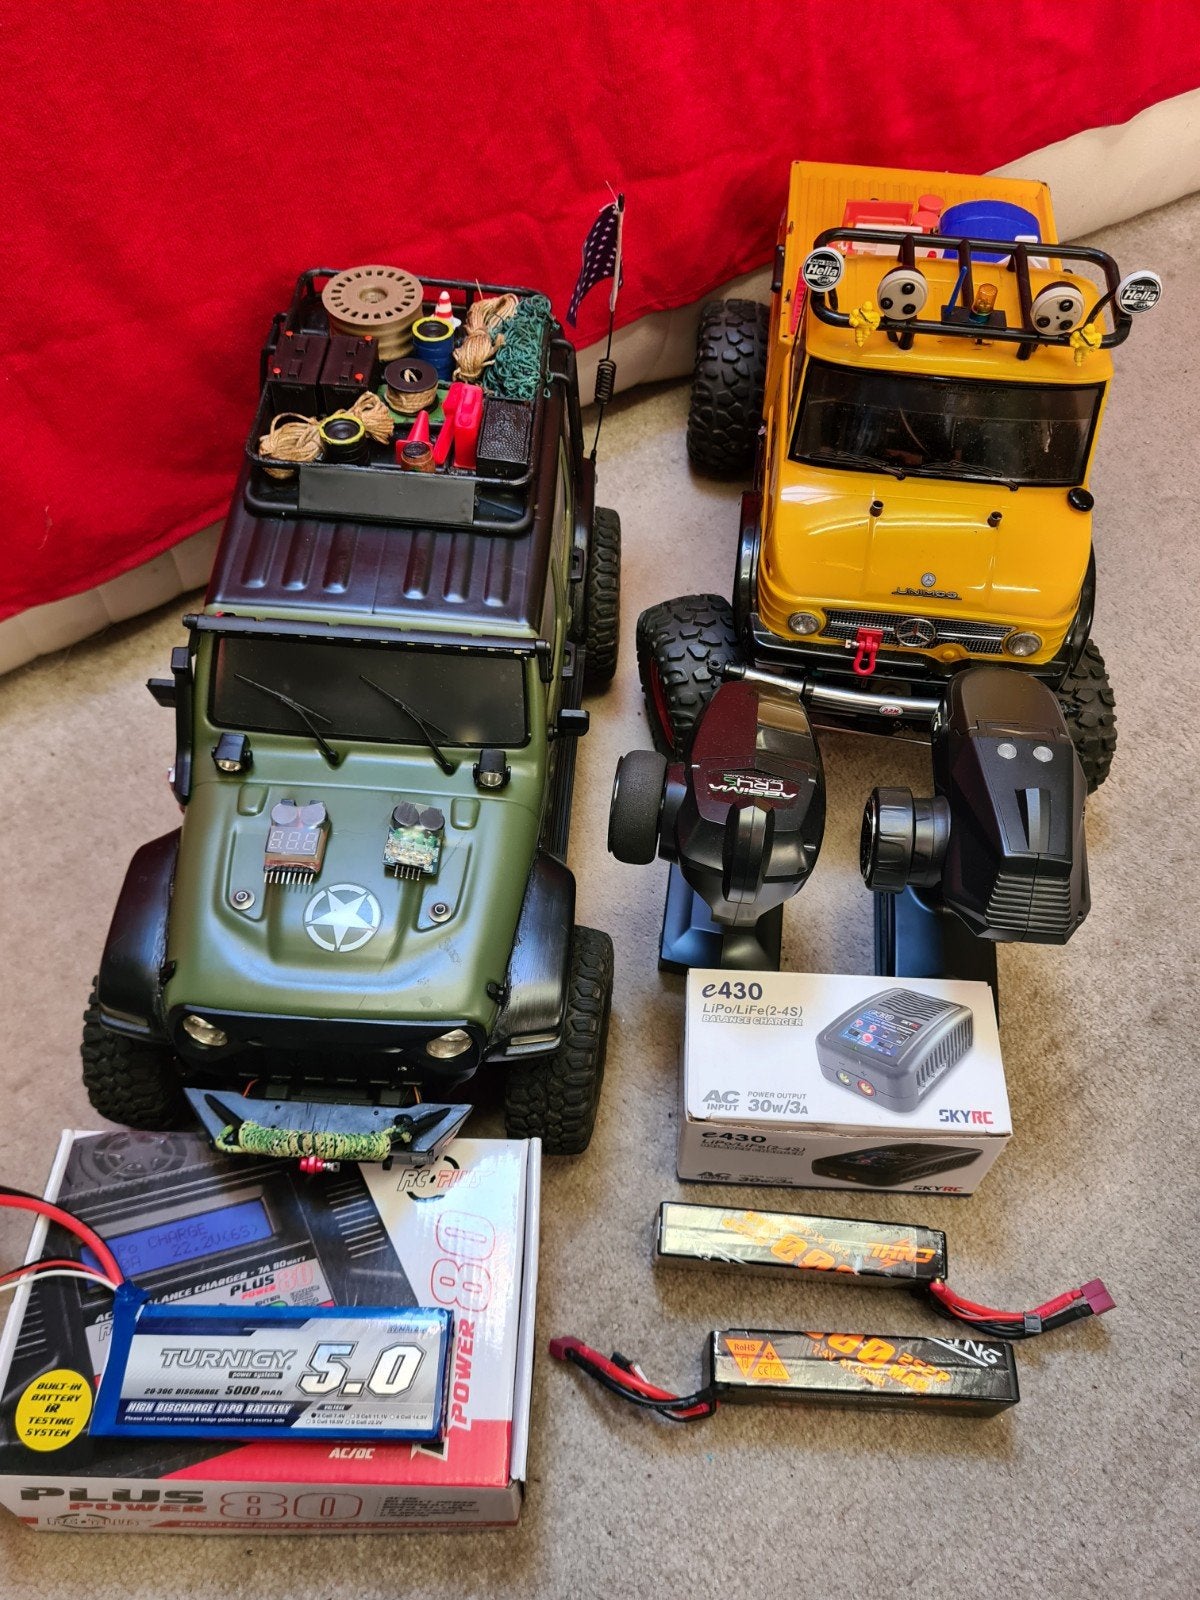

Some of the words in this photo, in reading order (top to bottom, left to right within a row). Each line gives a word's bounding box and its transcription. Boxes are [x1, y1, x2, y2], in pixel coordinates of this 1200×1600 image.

[806, 264, 839, 277] Hella
[1123, 290, 1157, 302] Hella
[702, 981, 763, 1001] e430
[702, 1003, 804, 1018] LiPo/LiFe(2-4S)
[701, 1014, 751, 1025] BALANCE
[752, 1017, 804, 1027] CHARGER
[702, 1089, 741, 1104] AC
[747, 1091, 775, 1099] POWER
[776, 1092, 807, 1100] OUTPUT
[707, 1103, 740, 1112] INPUT
[938, 1109, 994, 1125] SKYRC
[701, 1132, 767, 1143] e430
[397, 1169, 431, 1192] RC
[913, 1185, 963, 1193] SKYRC
[147, 1222, 209, 1249] CHARGE
[431, 1209, 496, 1312] 80
[194, 1271, 248, 1295] CHARGER
[258, 1264, 271, 1275] 7A
[229, 1273, 275, 1297] PLUS
[241, 1284, 276, 1300] POWER
[734, 1343, 757, 1352] RoHS
[811, 1343, 836, 1362] 7.4V
[161, 1348, 298, 1369] TURNIGY
[296, 1340, 427, 1398] 5.0
[450, 1318, 476, 1425] POWER
[897, 1352, 951, 1383] 2S2P
[232, 1372, 253, 1380] power
[254, 1372, 281, 1380] systems
[36, 1382, 82, 1391] BUILT-IN
[175, 1388, 220, 1397] DISCHARGE
[224, 1385, 261, 1397] 5000
[261, 1389, 284, 1397] mAh
[31, 1393, 82, 1402] BATTERY
[44, 1403, 61, 1413] IR
[125, 1402, 155, 1414] HIGH
[154, 1402, 216, 1415] DISCHARGE
[243, 1402, 295, 1416] BATTERY
[29, 1417, 76, 1426] TESTING
[25, 1429, 71, 1437] SYSTEM
[328, 1447, 376, 1459] AC/DC
[20, 1487, 204, 1504] PLUS
[69, 1503, 207, 1513] POWER
[220, 1491, 363, 1520] 80
